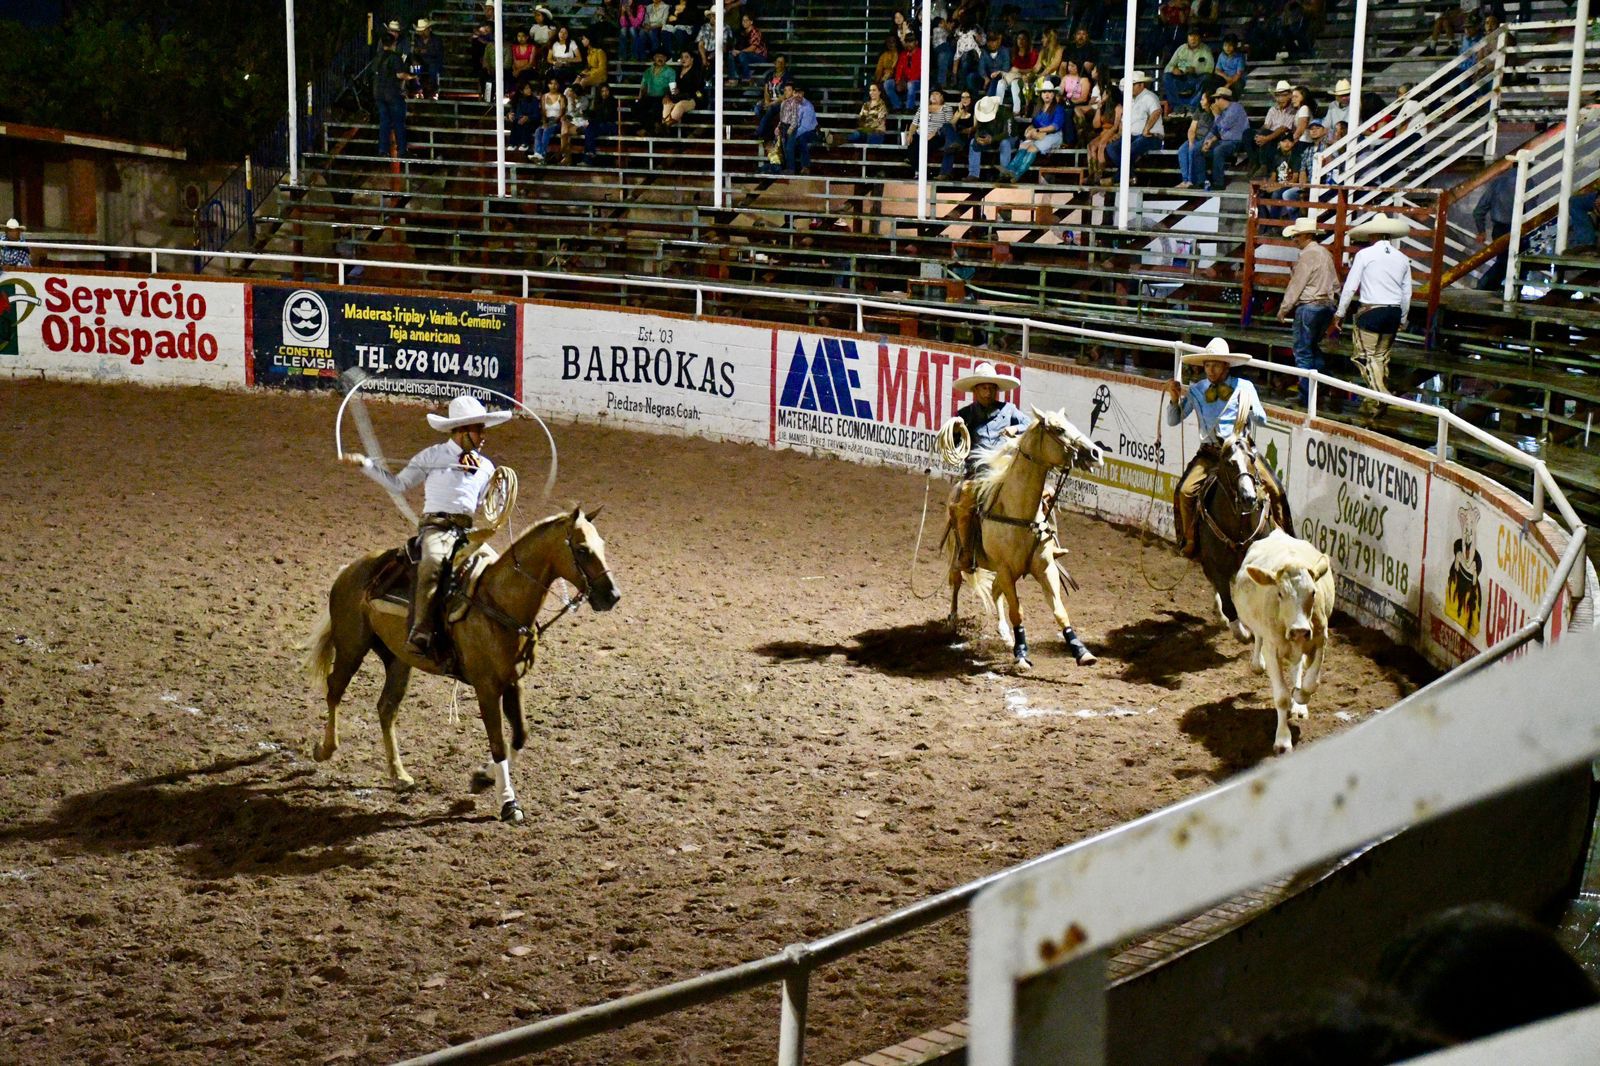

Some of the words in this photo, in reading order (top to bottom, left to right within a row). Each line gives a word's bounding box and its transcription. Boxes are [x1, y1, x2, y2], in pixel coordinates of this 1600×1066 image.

[44, 277, 207, 321] Servicio
[41, 314, 219, 365] Obispado
[388, 324, 408, 343] Teja
[409, 329, 461, 345] americana
[638, 326, 655, 343] Est.
[273, 355, 335, 370] CLEMSA
[278, 346, 332, 359] CONSTRU
[395, 348, 429, 372] 878
[431, 352, 460, 375] 104
[462, 354, 499, 380] 4310
[561, 345, 735, 399] BARROKAS
[361, 376, 491, 401] construclemsa@hotmail.com
[606, 391, 643, 413] Piedras
[777, 408, 833, 435] MATERIALES
[837, 418, 896, 446] ECONOMICOS
[898, 428, 909, 449] DE
[1306, 437, 1418, 510] CONSTRUYENDO
[1355, 544, 1377, 576] 791
[1381, 552, 1409, 596] 1818
